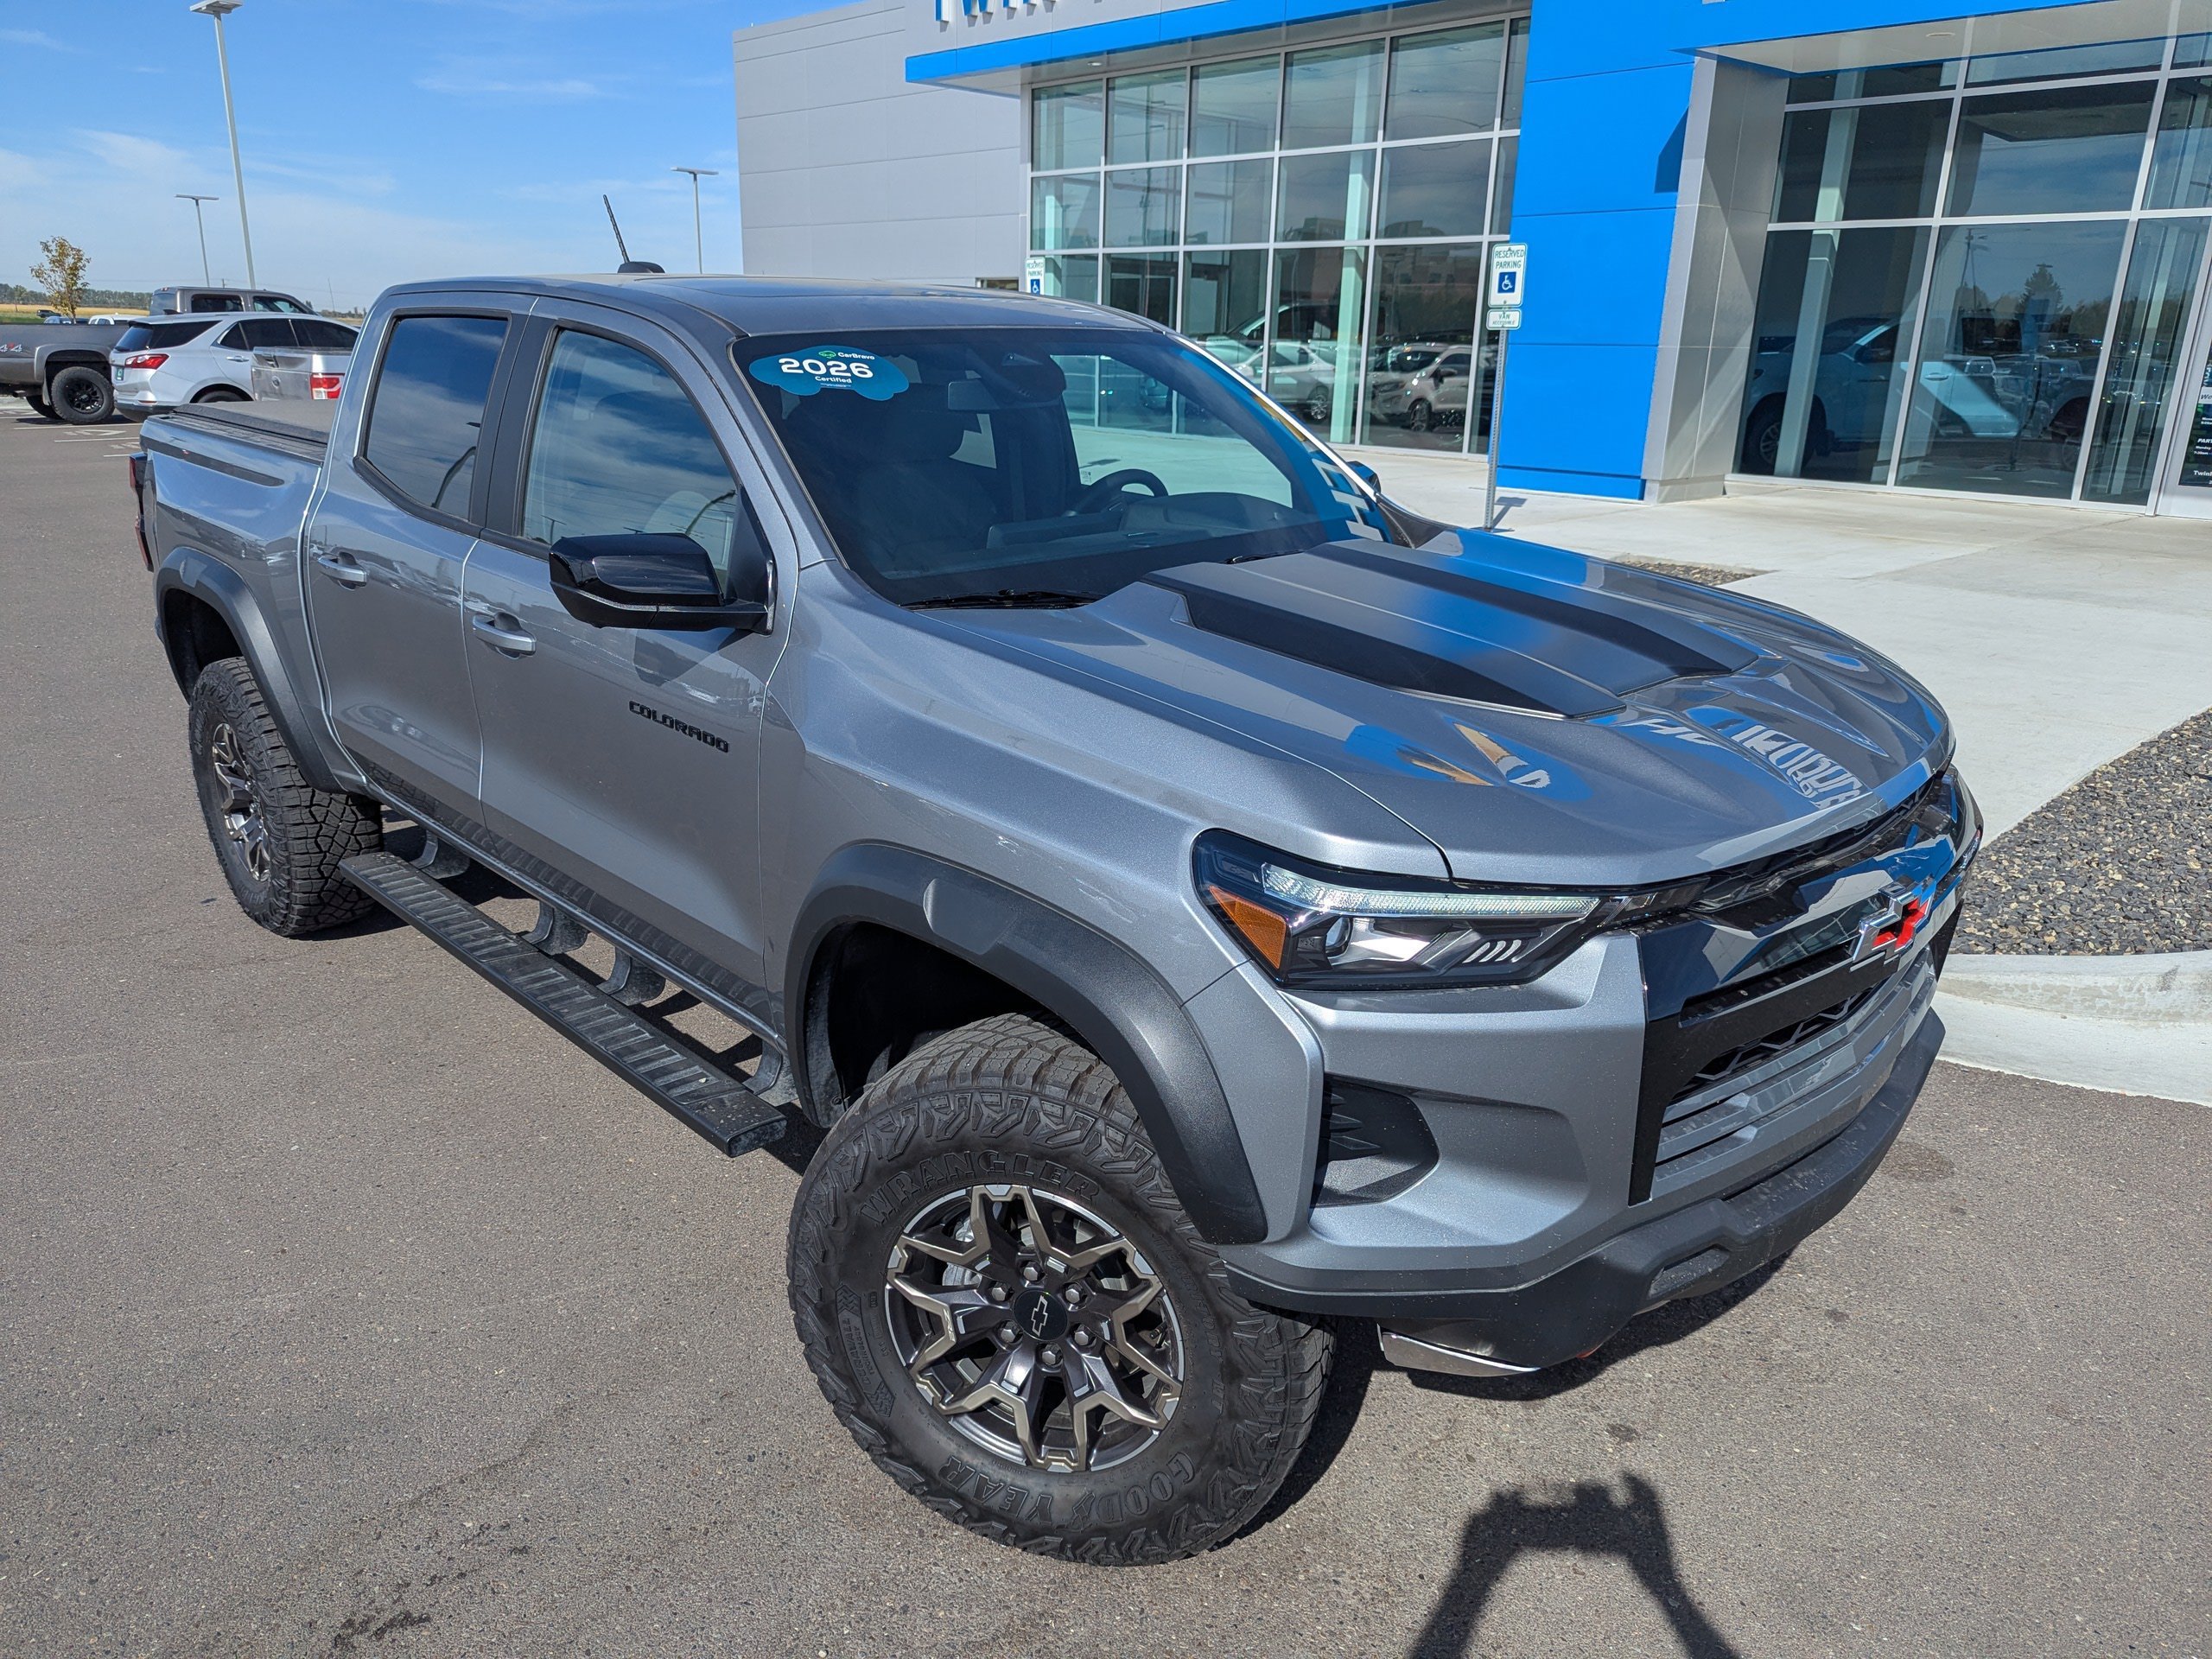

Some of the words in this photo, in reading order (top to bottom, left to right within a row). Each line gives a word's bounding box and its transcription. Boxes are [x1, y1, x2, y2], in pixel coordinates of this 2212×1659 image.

[1494, 249, 1524, 258] RESERVED
[1495, 260, 1522, 270] PARKING
[837, 352, 875, 360] CarBravo
[779, 358, 874, 378] 2026
[629, 700, 729, 753] COLORADO
[860, 1150, 1100, 1226] WRANGLER
